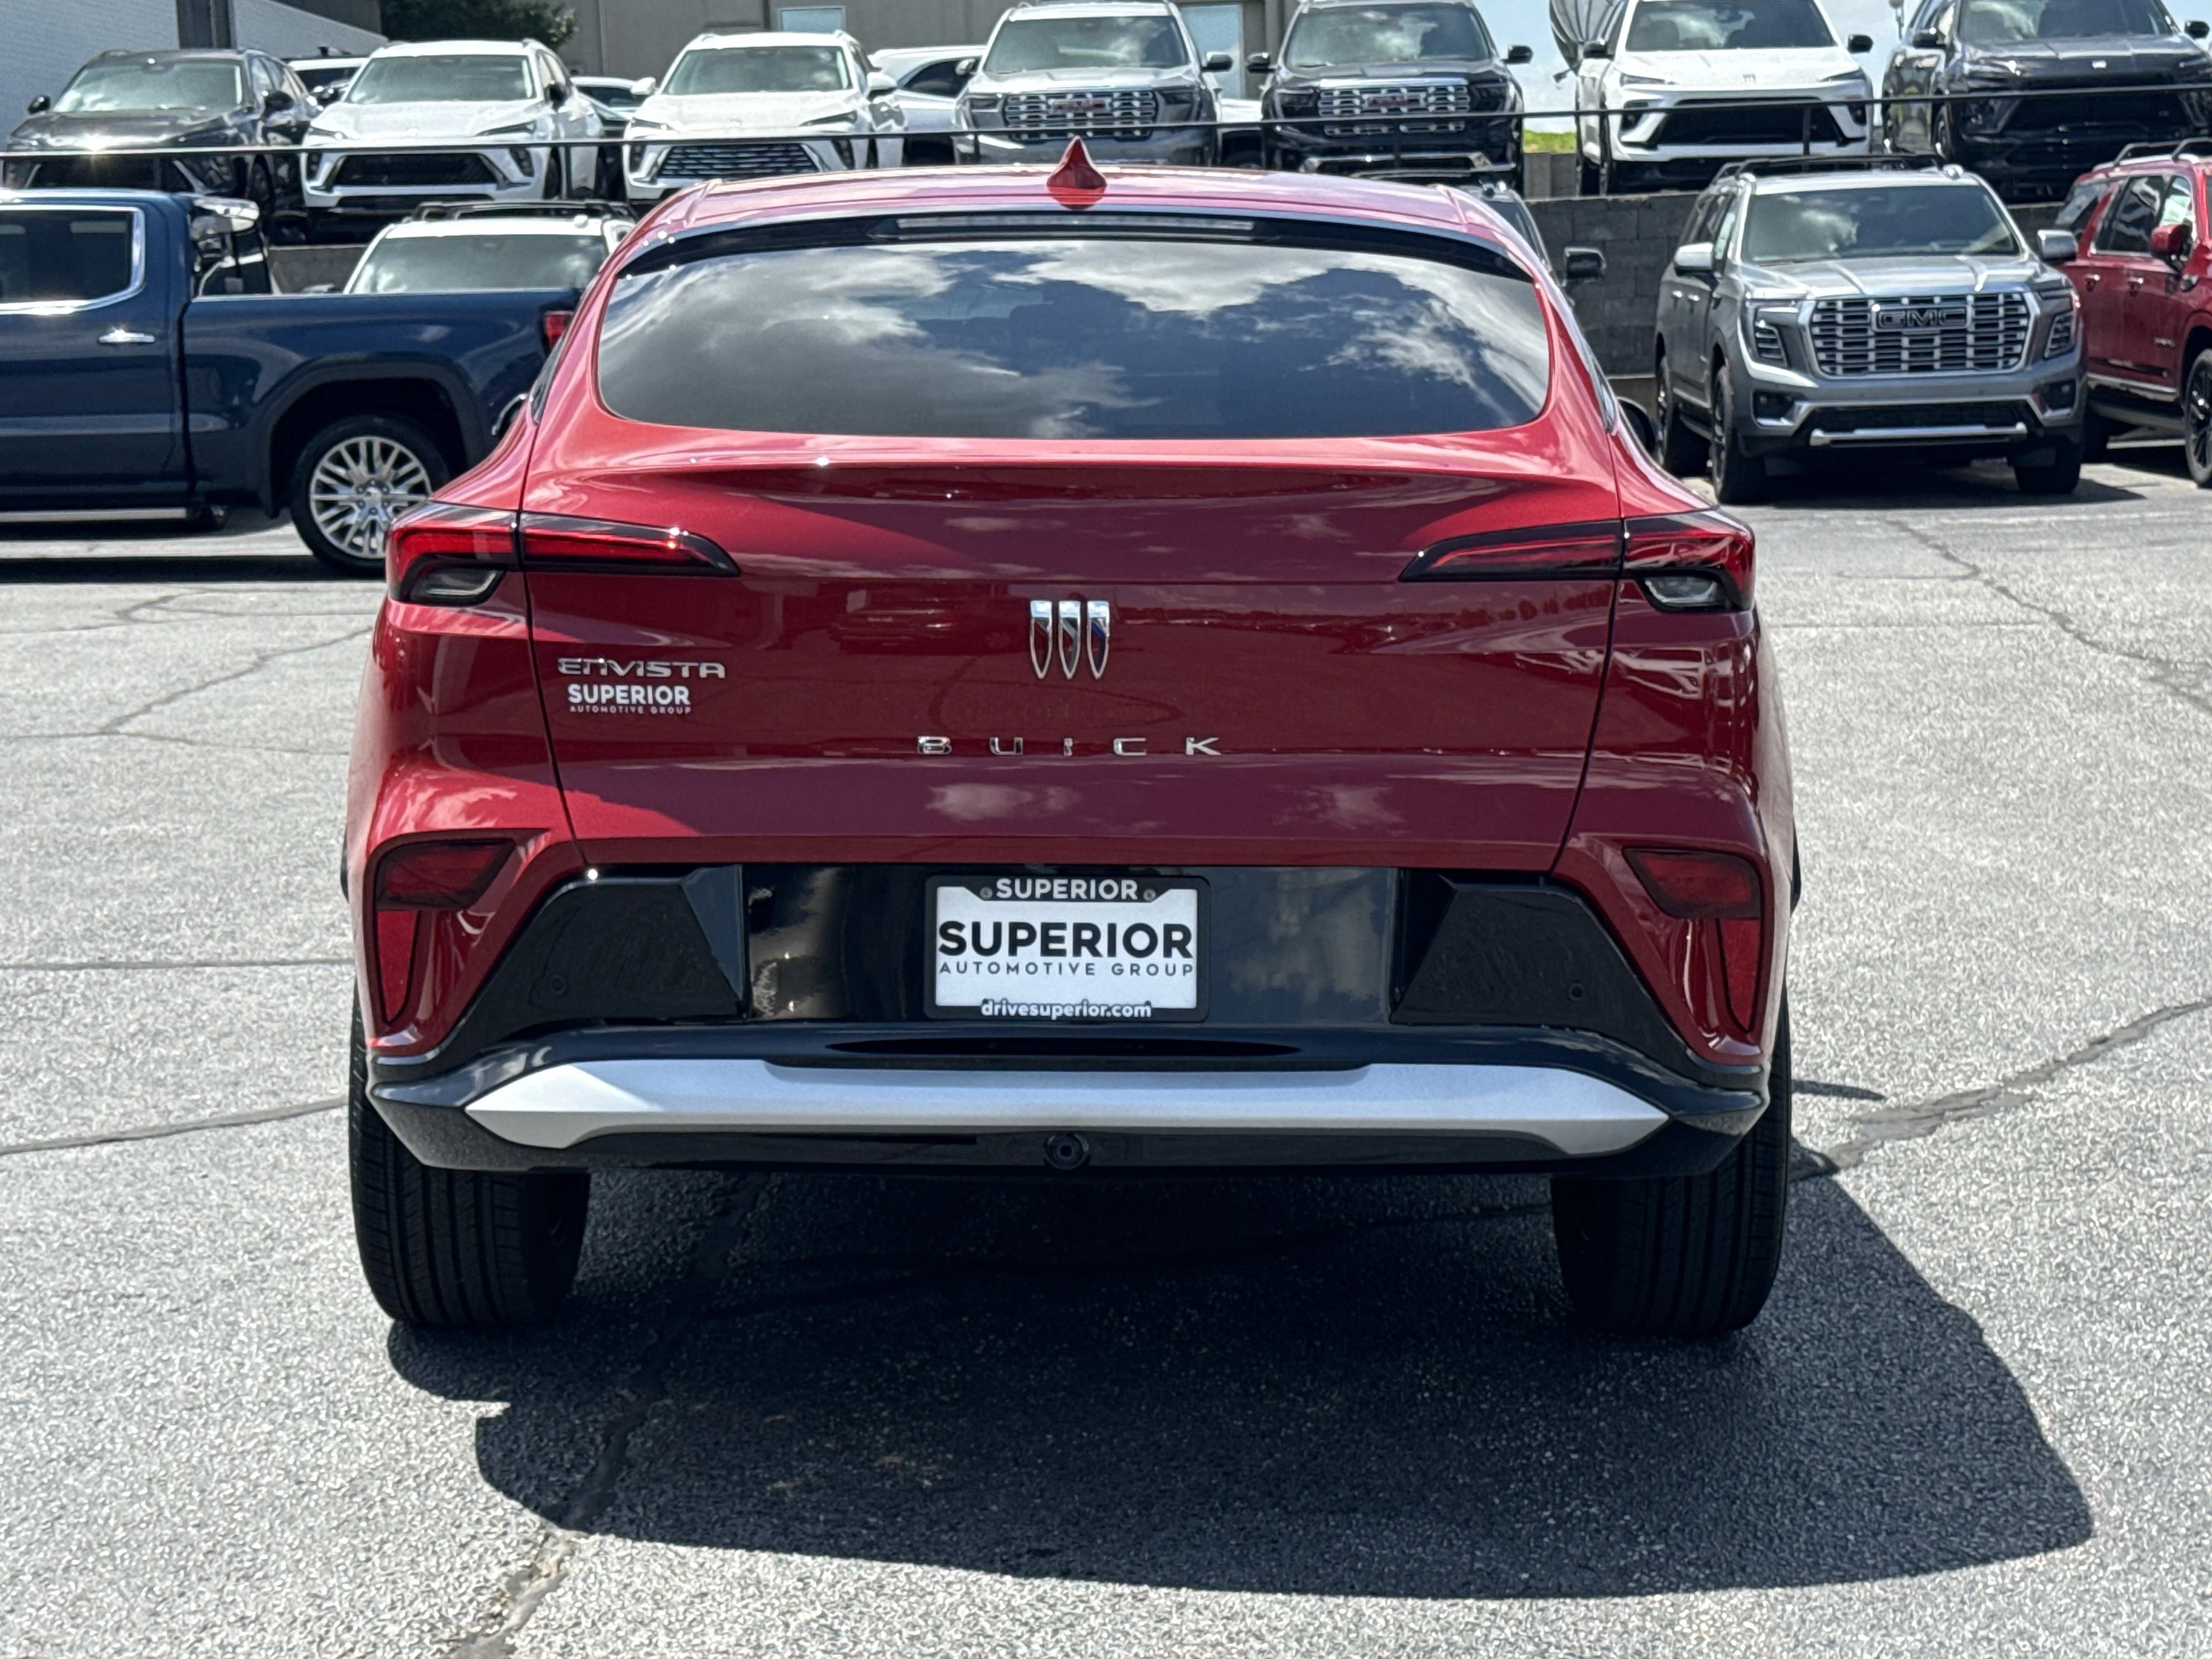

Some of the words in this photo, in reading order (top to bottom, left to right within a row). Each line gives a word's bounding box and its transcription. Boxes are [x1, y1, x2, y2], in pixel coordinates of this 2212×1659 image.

[1878, 308, 1966, 328] GMC
[557, 658, 725, 678] ENVISTA
[568, 684, 691, 705] SUPERIOR
[569, 706, 644, 714] AUTOMOTIVE
[650, 706, 691, 715] GROUP
[917, 735, 1221, 756] BUICK
[996, 878, 1138, 900] SUPERIOR
[938, 921, 1194, 958] SUPERIOR
[939, 961, 1096, 975] AUTOMOTIVE
[1111, 962, 1193, 976] GROUP
[981, 998, 1152, 1020] drivesuperior.com
